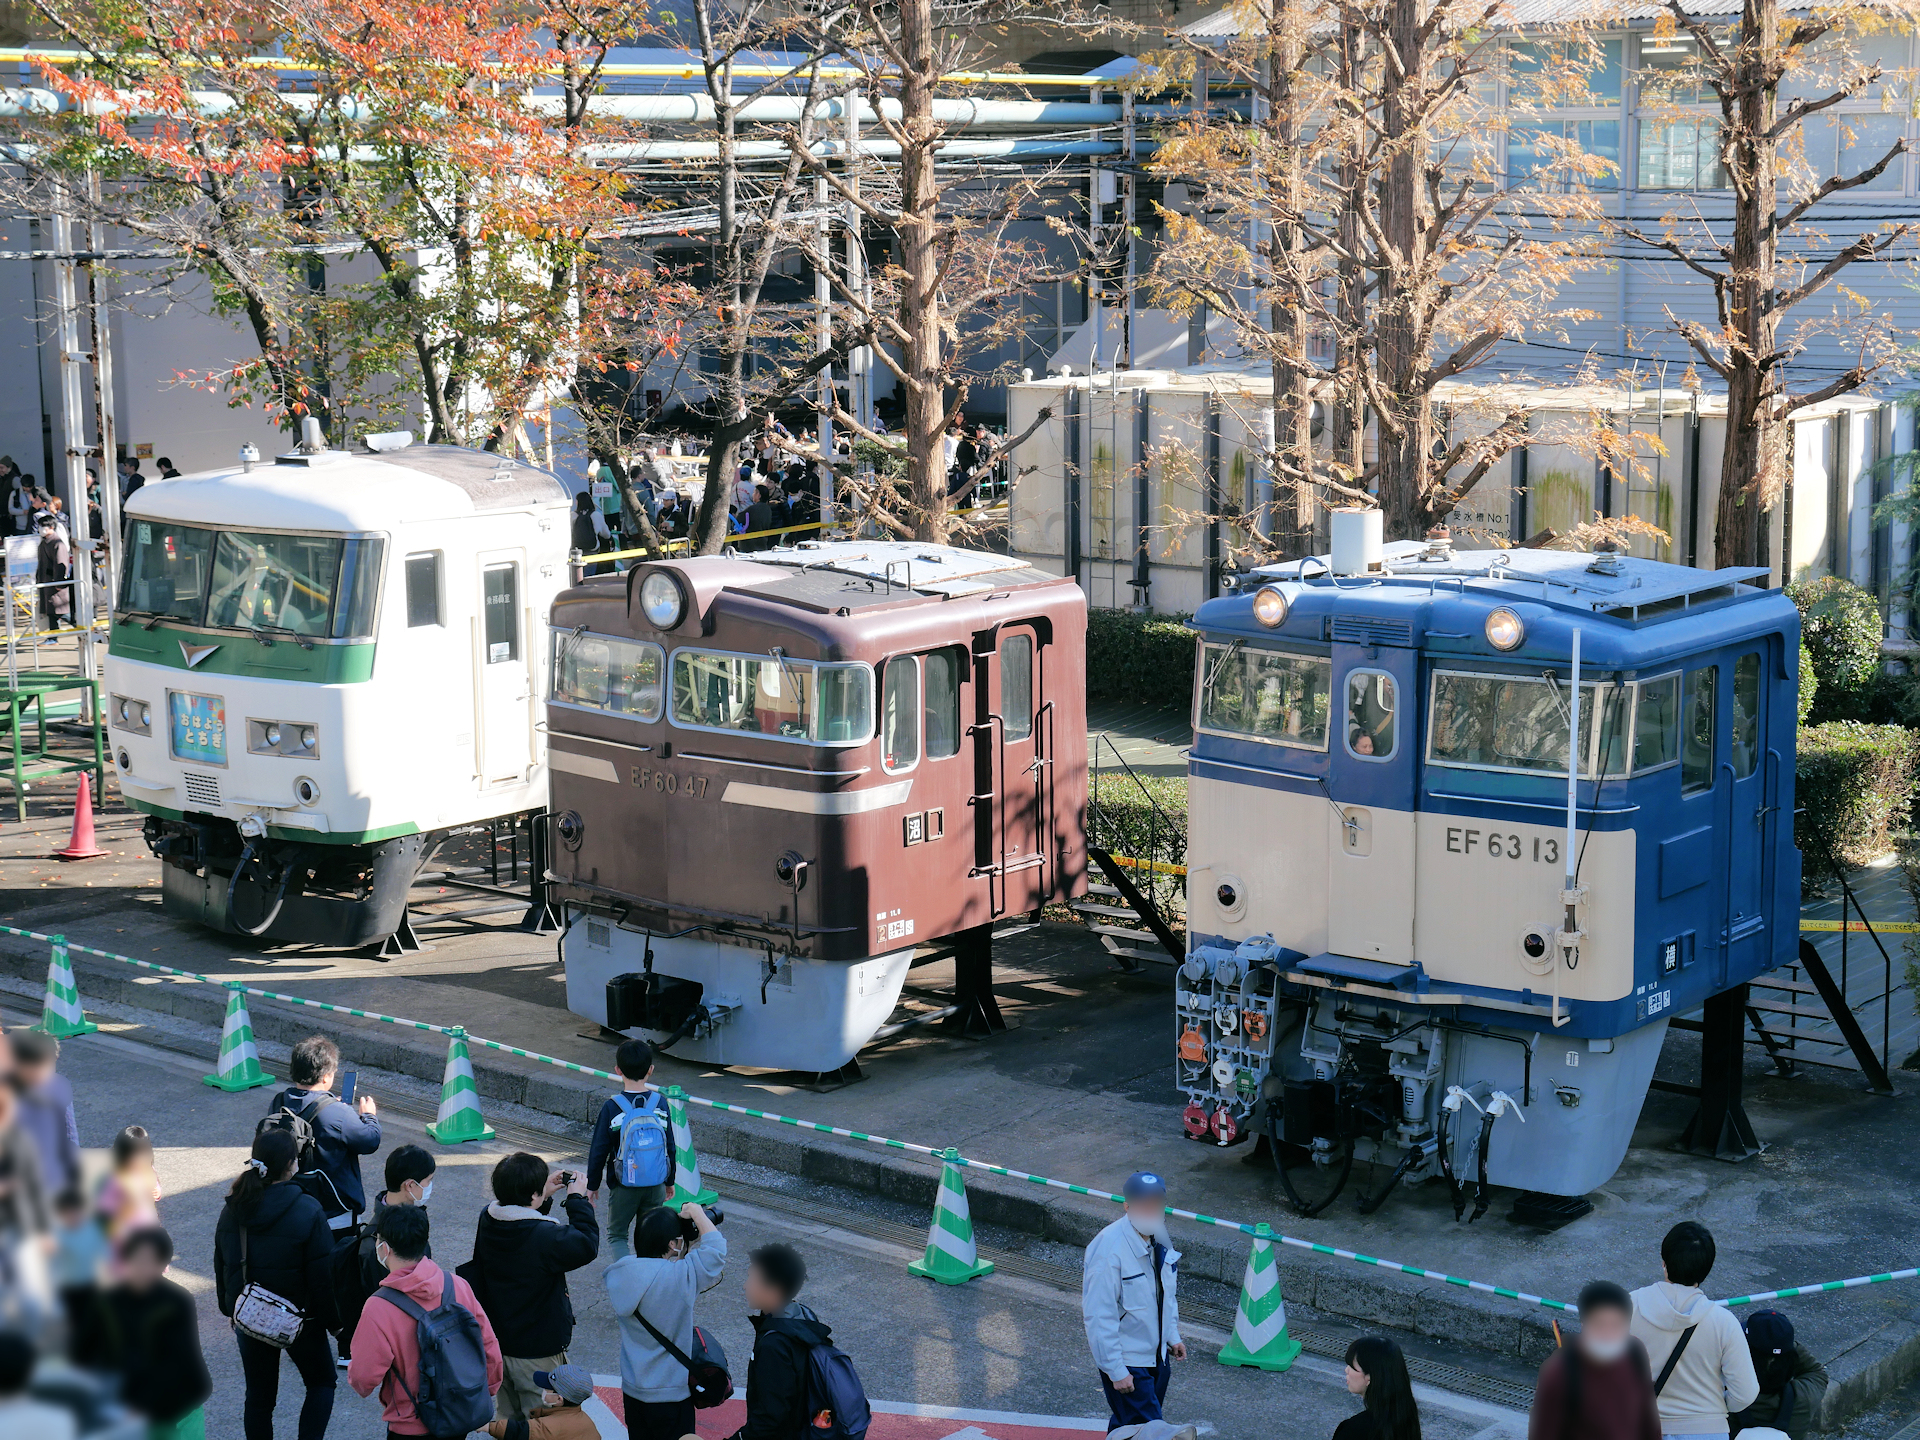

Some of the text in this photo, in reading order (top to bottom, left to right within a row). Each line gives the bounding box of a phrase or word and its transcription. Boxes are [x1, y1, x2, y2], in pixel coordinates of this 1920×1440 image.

[1454, 510, 1509, 523] 受水槽 No.1
[181, 713, 224, 732] おはよう
[185, 728, 223, 749] とちぎ
[684, 776, 708, 798] 47
[1533, 836, 1559, 864] 13
[1665, 944, 1676, 969] 横
